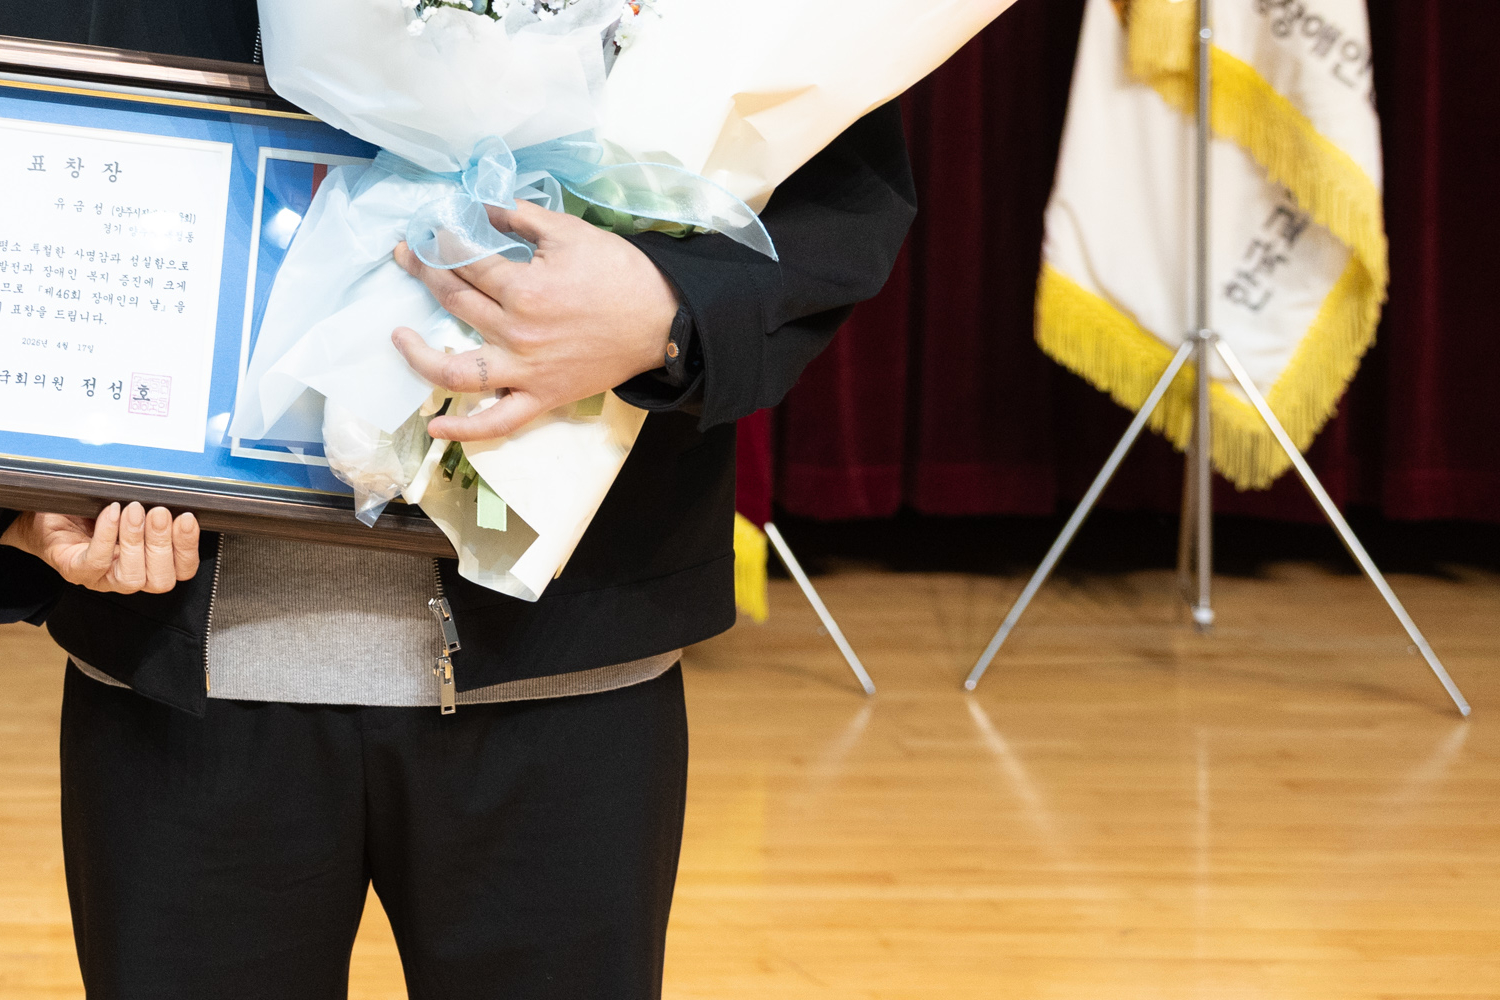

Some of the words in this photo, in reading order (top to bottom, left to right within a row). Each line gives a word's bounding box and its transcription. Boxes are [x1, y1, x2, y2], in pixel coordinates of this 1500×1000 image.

[103, 222, 123, 236] 경기
[29, 243, 66, 258] 투철한
[74, 247, 121, 264] 사명감과
[130, 254, 190, 272] 성실함으로
[43, 265, 78, 281] 장애인
[86, 270, 110, 283] 복지
[119, 273, 154, 289] 증진에
[163, 280, 187, 292] 크게
[91, 291, 139, 307] 장애인의
[10, 304, 47, 319] 표창을
[54, 309, 107, 325] 드립니다.
[21, 337, 48, 349] 2026년
[56, 341, 69, 351] 4월
[77, 343, 94, 354] 17일
